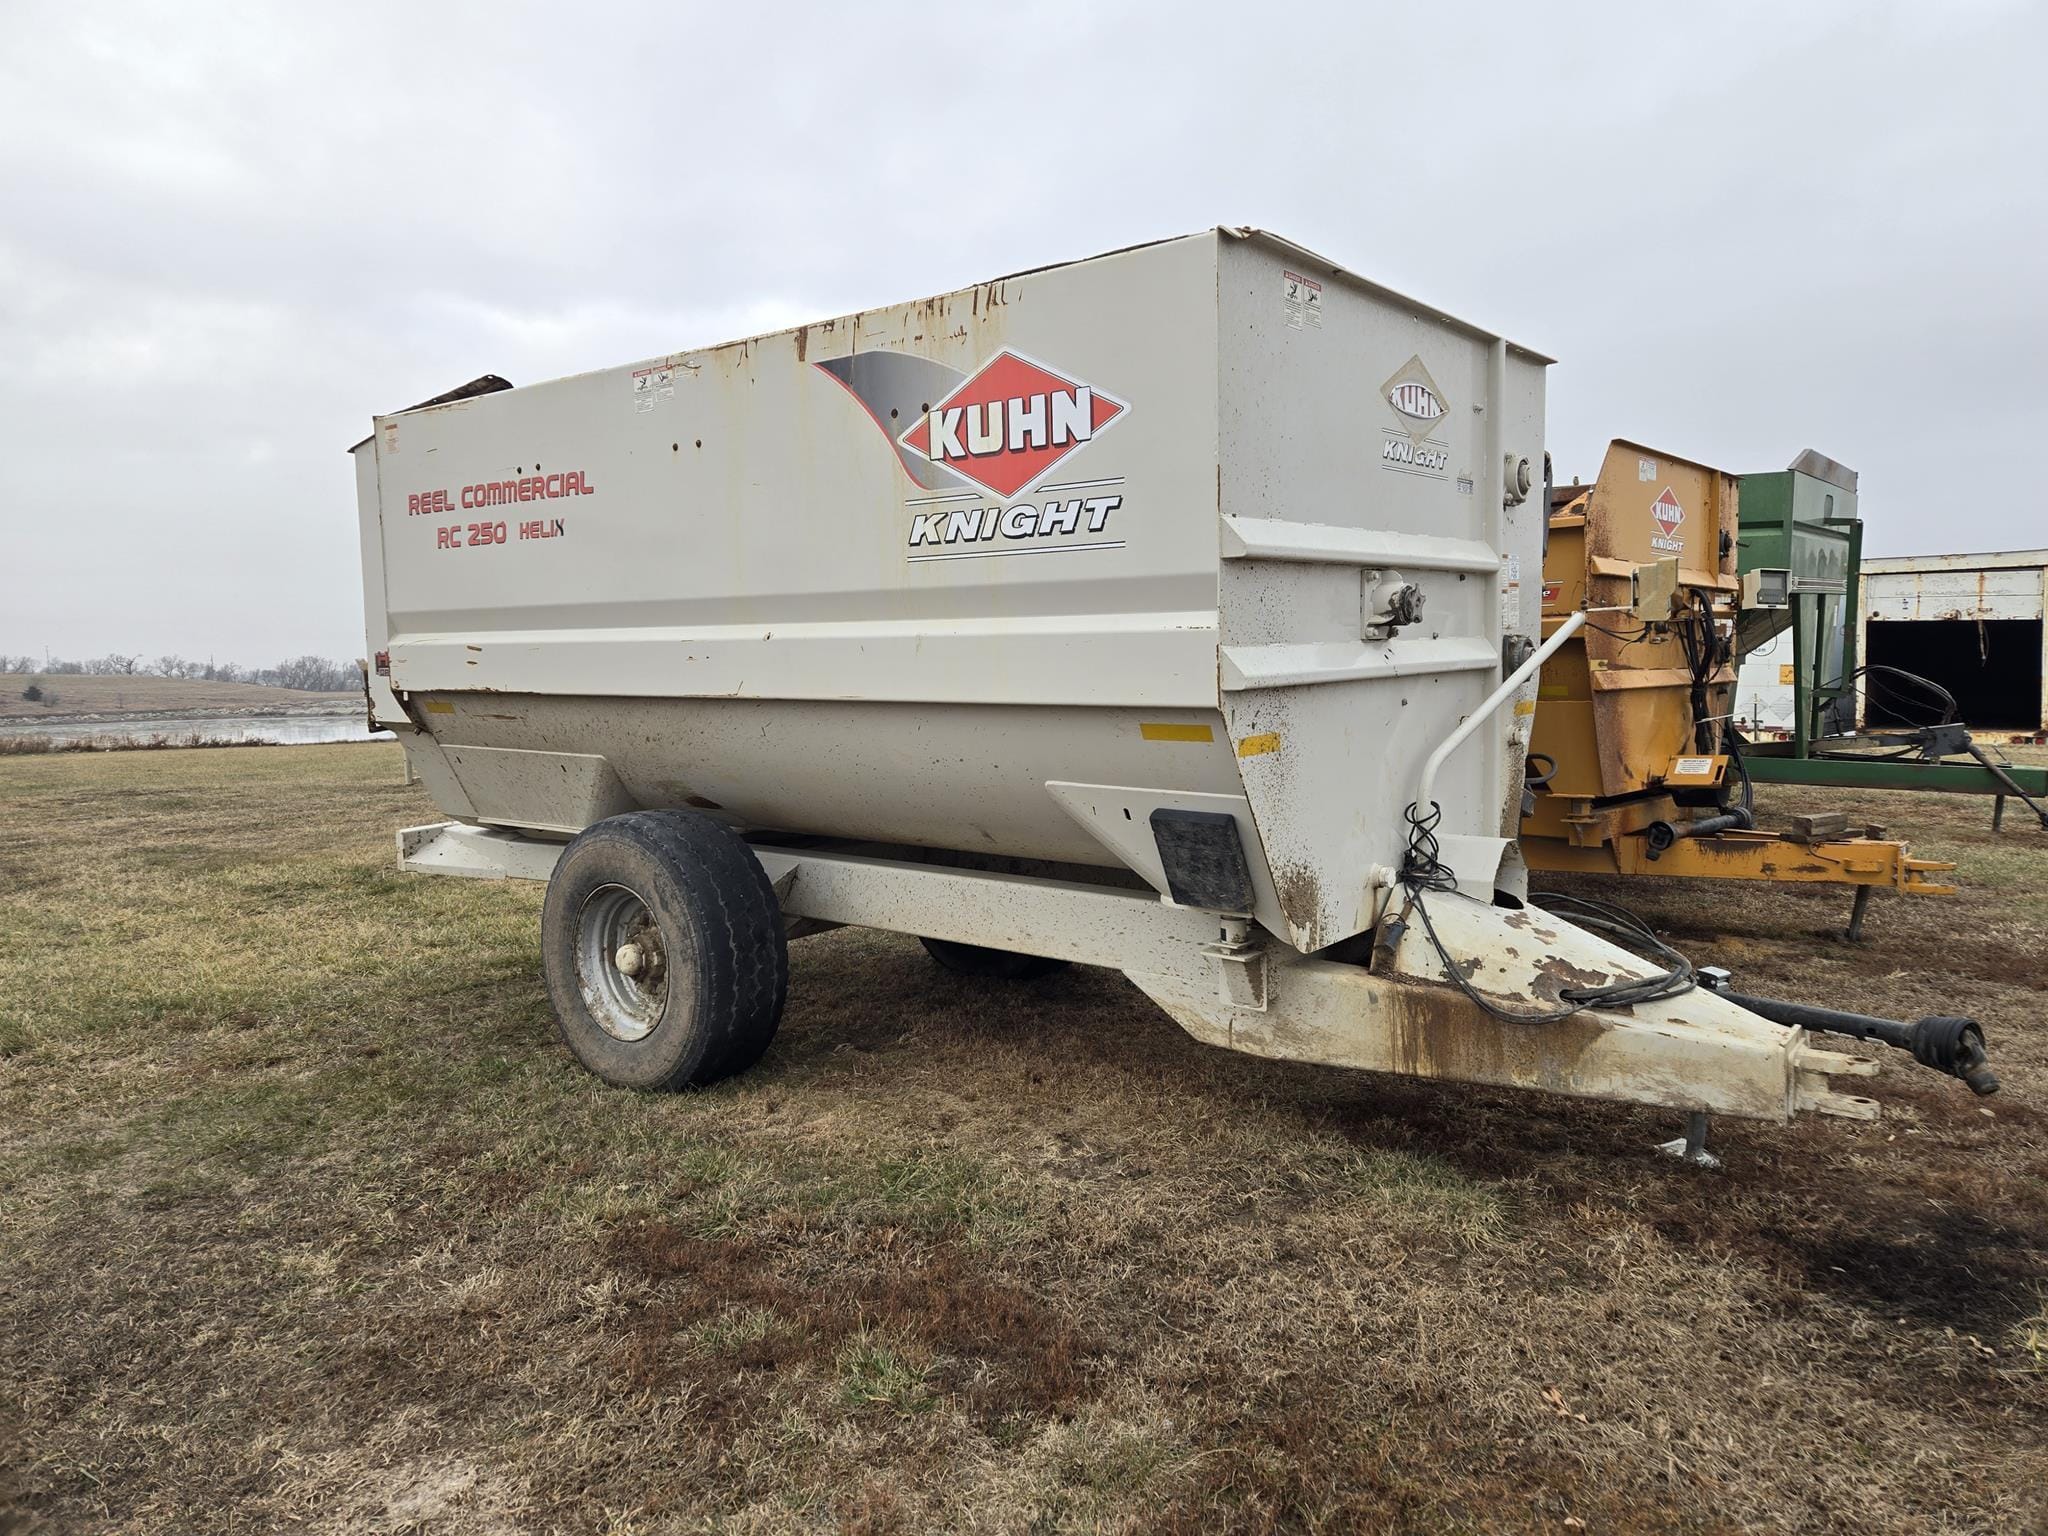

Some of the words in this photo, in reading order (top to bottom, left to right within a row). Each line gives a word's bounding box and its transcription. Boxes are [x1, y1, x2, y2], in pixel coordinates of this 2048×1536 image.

[929, 385, 1092, 461] KUHN
[1383, 440, 1447, 470] KNIGHT
[408, 489, 455, 516] REEL
[461, 471, 594, 508] COMMERCIAL
[908, 495, 1123, 546] KNIGHT
[1655, 502, 1681, 524] KUHN
[437, 526, 462, 549] RC
[467, 521, 507, 546] 250
[519, 519, 565, 540] HELIX
[1651, 538, 1684, 553] KNIGHT
